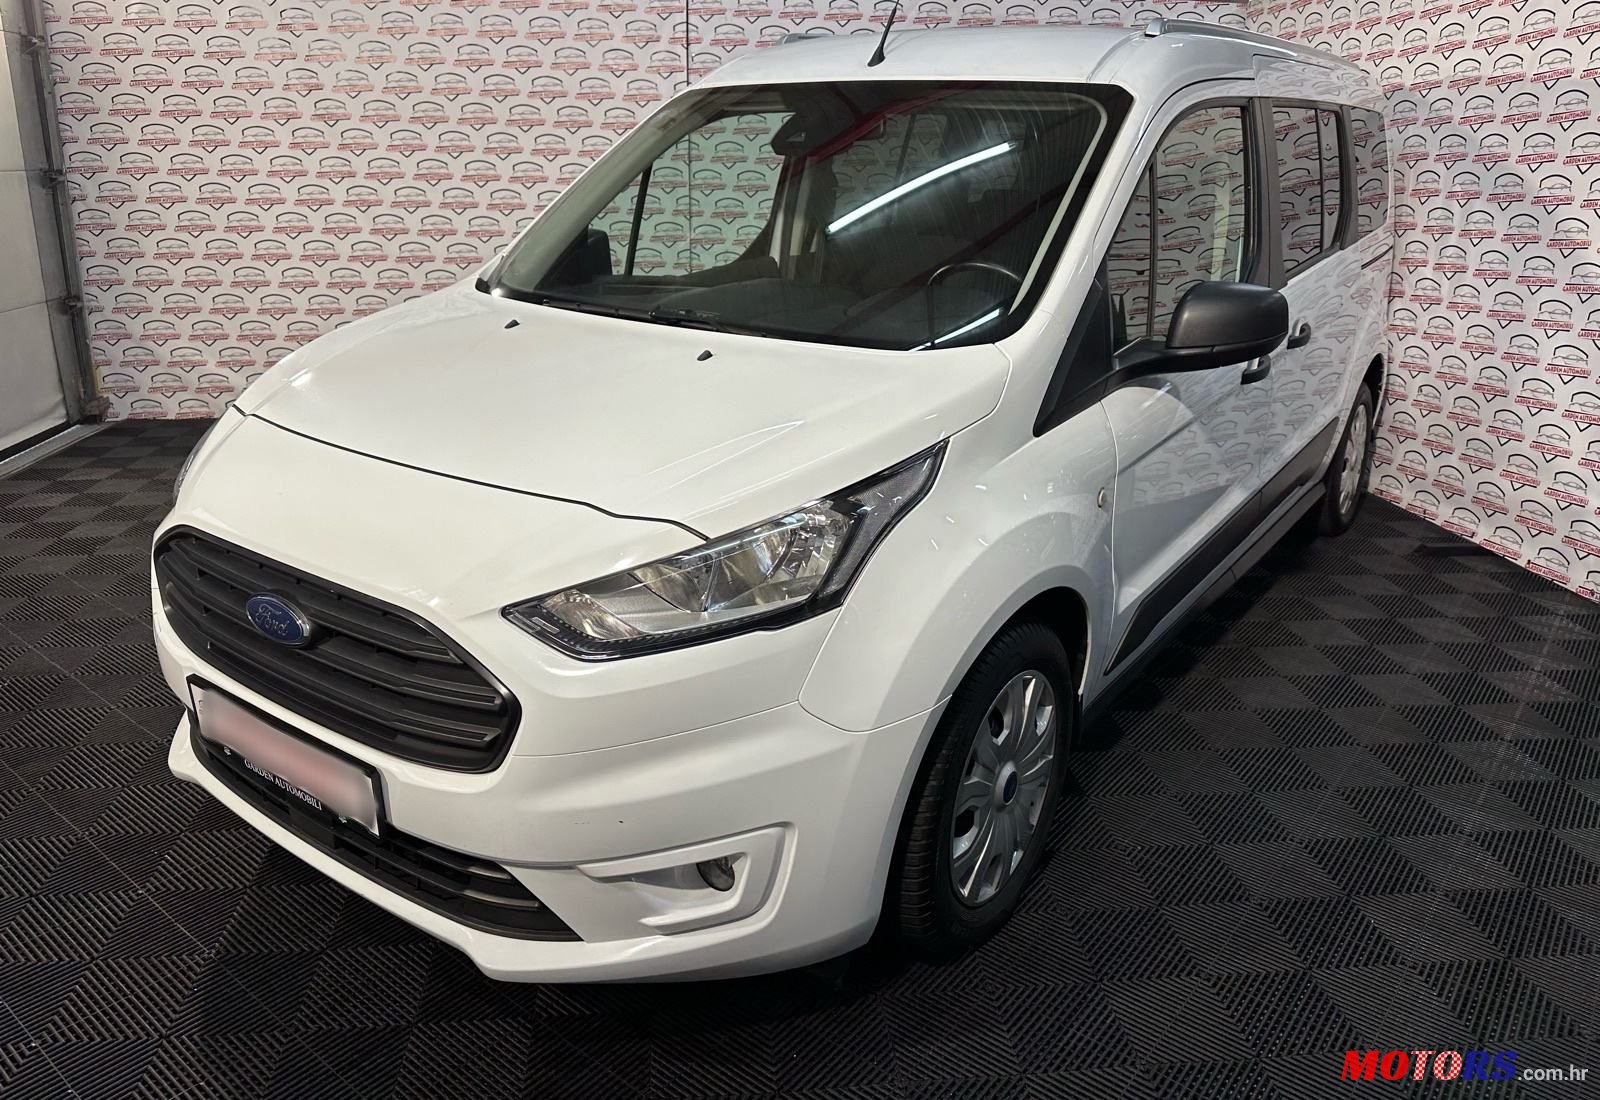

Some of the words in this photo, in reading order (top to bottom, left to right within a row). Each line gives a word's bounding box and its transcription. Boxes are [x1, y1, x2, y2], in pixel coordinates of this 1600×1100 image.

[1515, 34, 1531, 44] GARDEN
[1531, 27, 1558, 39] AUTOMOBILI
[1563, 28, 1580, 38] GARDEN
[1530, 74, 1547, 82] GARDEN
[1547, 67, 1575, 78] AUTOMOBILI
[1579, 70, 1598, 79] GARDEN
[1546, 115, 1563, 123] GARDEN
[1563, 109, 1591, 119] AUTOMOBILI
[1531, 153, 1557, 161] AUTOMOBILI
[1563, 368, 1591, 376] AUTOMOBILI
[1531, 400, 1557, 409] AUTOMOBILI
[1546, 446, 1573, 456] AUTOMOBILI
[1577, 459, 1595, 468] GARDEN
[1543, 489, 1560, 498] GARDEN
[1560, 493, 1589, 505] AUTOMOBILI
[1514, 516, 1529, 525] GARDEN
[1530, 521, 1556, 534] AUTOMOBILI
[1561, 537, 1578, 546] GARDEN
[256, 604, 289, 636] Ford
[244, 759, 274, 782] GARDEN
[275, 776, 322, 810] AUTOMOBILI
